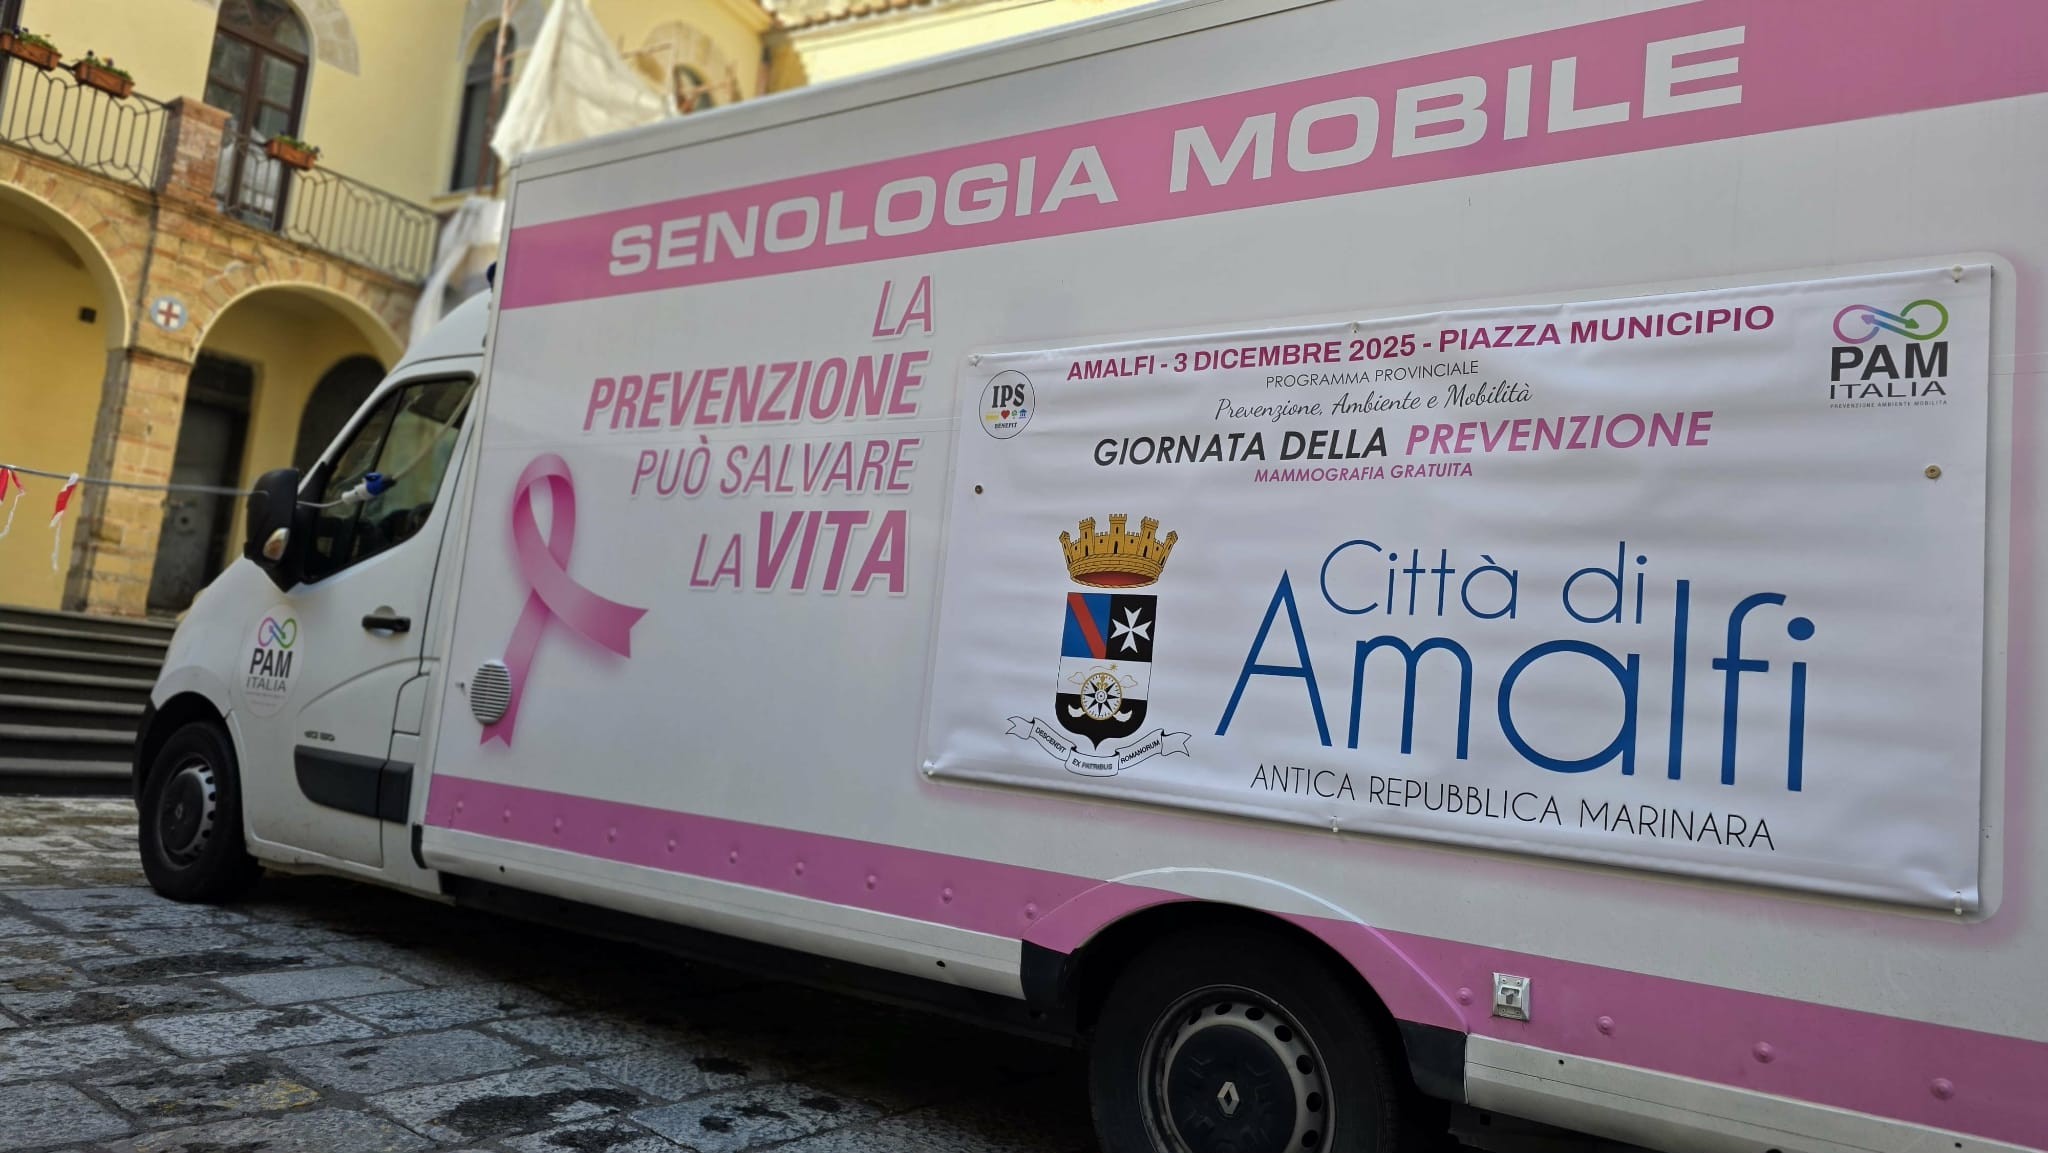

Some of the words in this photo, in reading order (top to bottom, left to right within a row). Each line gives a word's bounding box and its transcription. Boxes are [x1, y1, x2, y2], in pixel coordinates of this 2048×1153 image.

[609, 145, 1118, 277] SENOLOGIA
[1169, 25, 1746, 193] MOBILE
[872, 275, 934, 337] LA
[1067, 354, 1155, 381] AMALFI
[1173, 352, 1188, 373] 3
[1193, 341, 1342, 372] DICEMBRE
[1349, 333, 1416, 362] 2025
[1439, 323, 1561, 352] PIAZZA
[1569, 305, 1775, 345] MUNICIPIO
[1831, 341, 1948, 382] PAM
[583, 350, 929, 431] PREVENZIONE
[992, 383, 1025, 408] IPS
[1266, 373, 1370, 389] PROGRAMMA
[1375, 360, 1479, 382] PROVINCIALE
[1332, 391, 1421, 416] Ambiente
[1427, 394, 1439, 409] e
[1444, 380, 1533, 409] Mobilità
[1830, 381, 1947, 400] ITALIA
[631, 434, 710, 495] PUÒ
[719, 438, 921, 494] SALVARE
[1094, 432, 1266, 466] GIORNATA
[1279, 427, 1387, 461] DELLA
[1405, 411, 1713, 456] PREVENZIONE
[1254, 466, 1385, 483] MAMMOGRAFIA
[1391, 462, 1473, 479] GRATUITA
[689, 533, 742, 588] LA
[754, 510, 908, 593] VITA
[1320, 539, 1518, 619] Città
[1562, 541, 1648, 625] di
[246, 676, 286, 692] ITALIA
[249, 647, 293, 678] PAM
[1214, 569, 1815, 792] Amalfi
[1035, 727, 1067, 753] DESCENDIT
[1072, 758, 1080, 768] EX
[1120, 740, 1160, 764] ROMANORUM
[1250, 763, 1355, 801] ANTICA
[1369, 775, 1562, 826] REPUBBLICA
[1579, 799, 1775, 851] MARINARA
